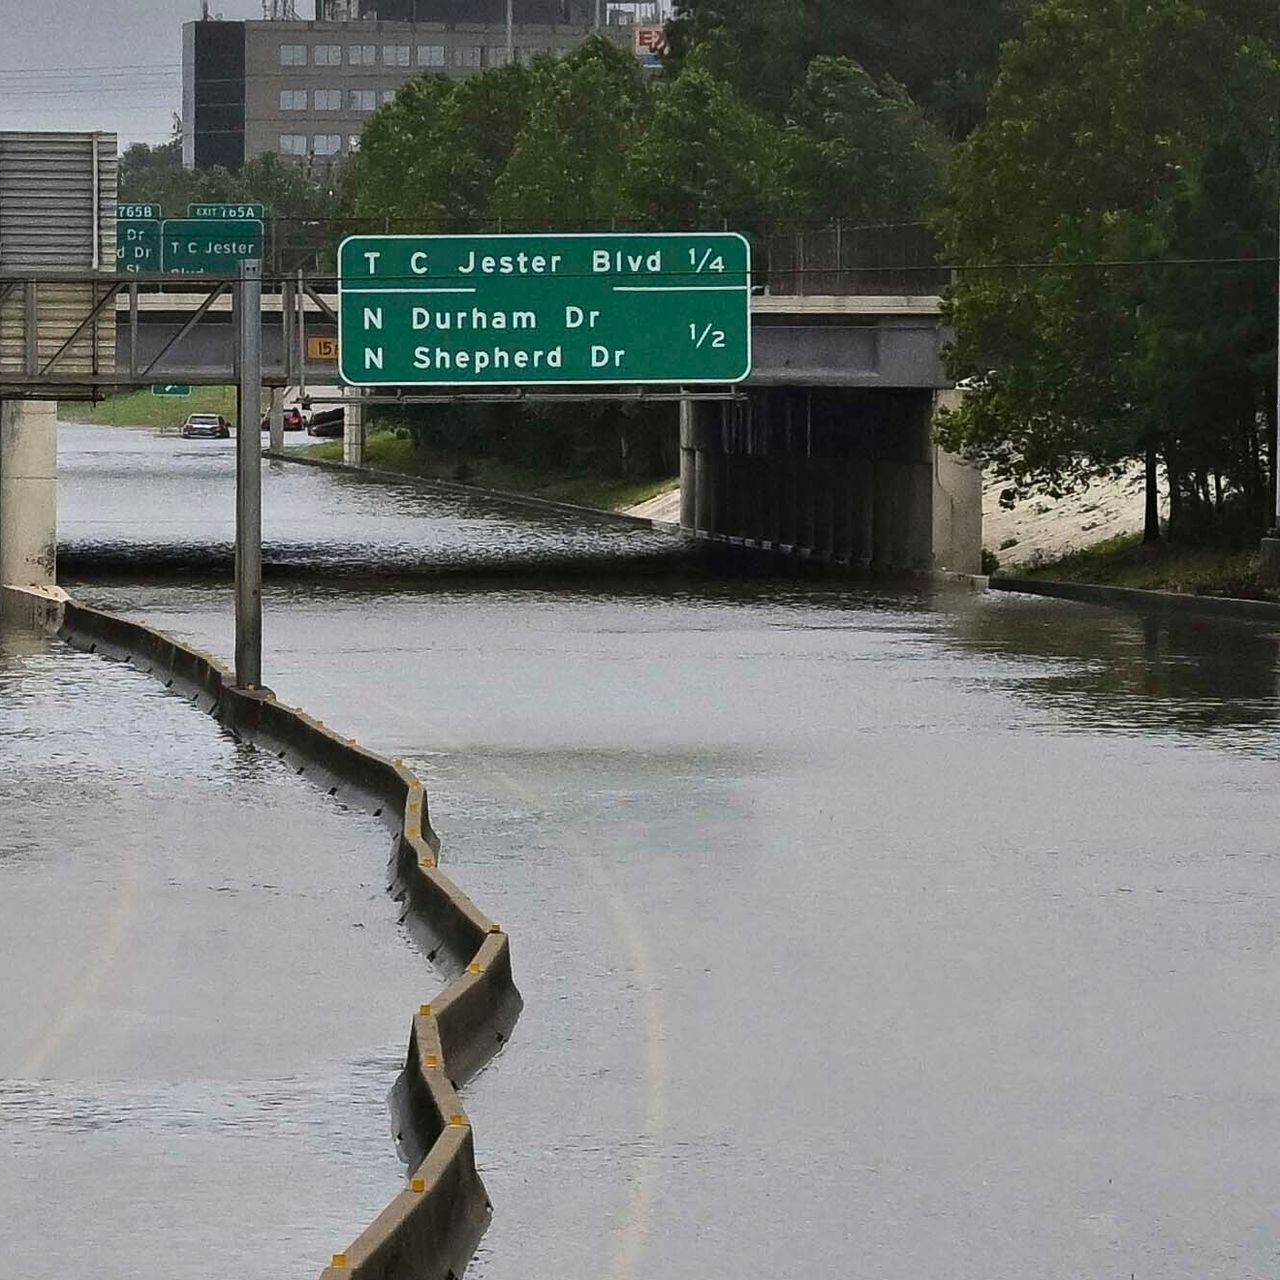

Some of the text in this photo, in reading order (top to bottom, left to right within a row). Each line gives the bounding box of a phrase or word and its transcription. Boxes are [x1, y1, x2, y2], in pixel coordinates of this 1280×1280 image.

[118, 206, 153, 218] 765B
[196, 206, 255, 218] EXIT 765A
[127, 229, 145, 241] Dr
[134, 247, 152, 259] Dr
[171, 241, 255, 254] T C Jester
[364, 248, 725, 274] T C Jester Blvd 1/4
[363, 306, 600, 330] N Durham Dr
[689, 323, 726, 349] 1/2
[364, 345, 626, 373] N Shepherd Dr
